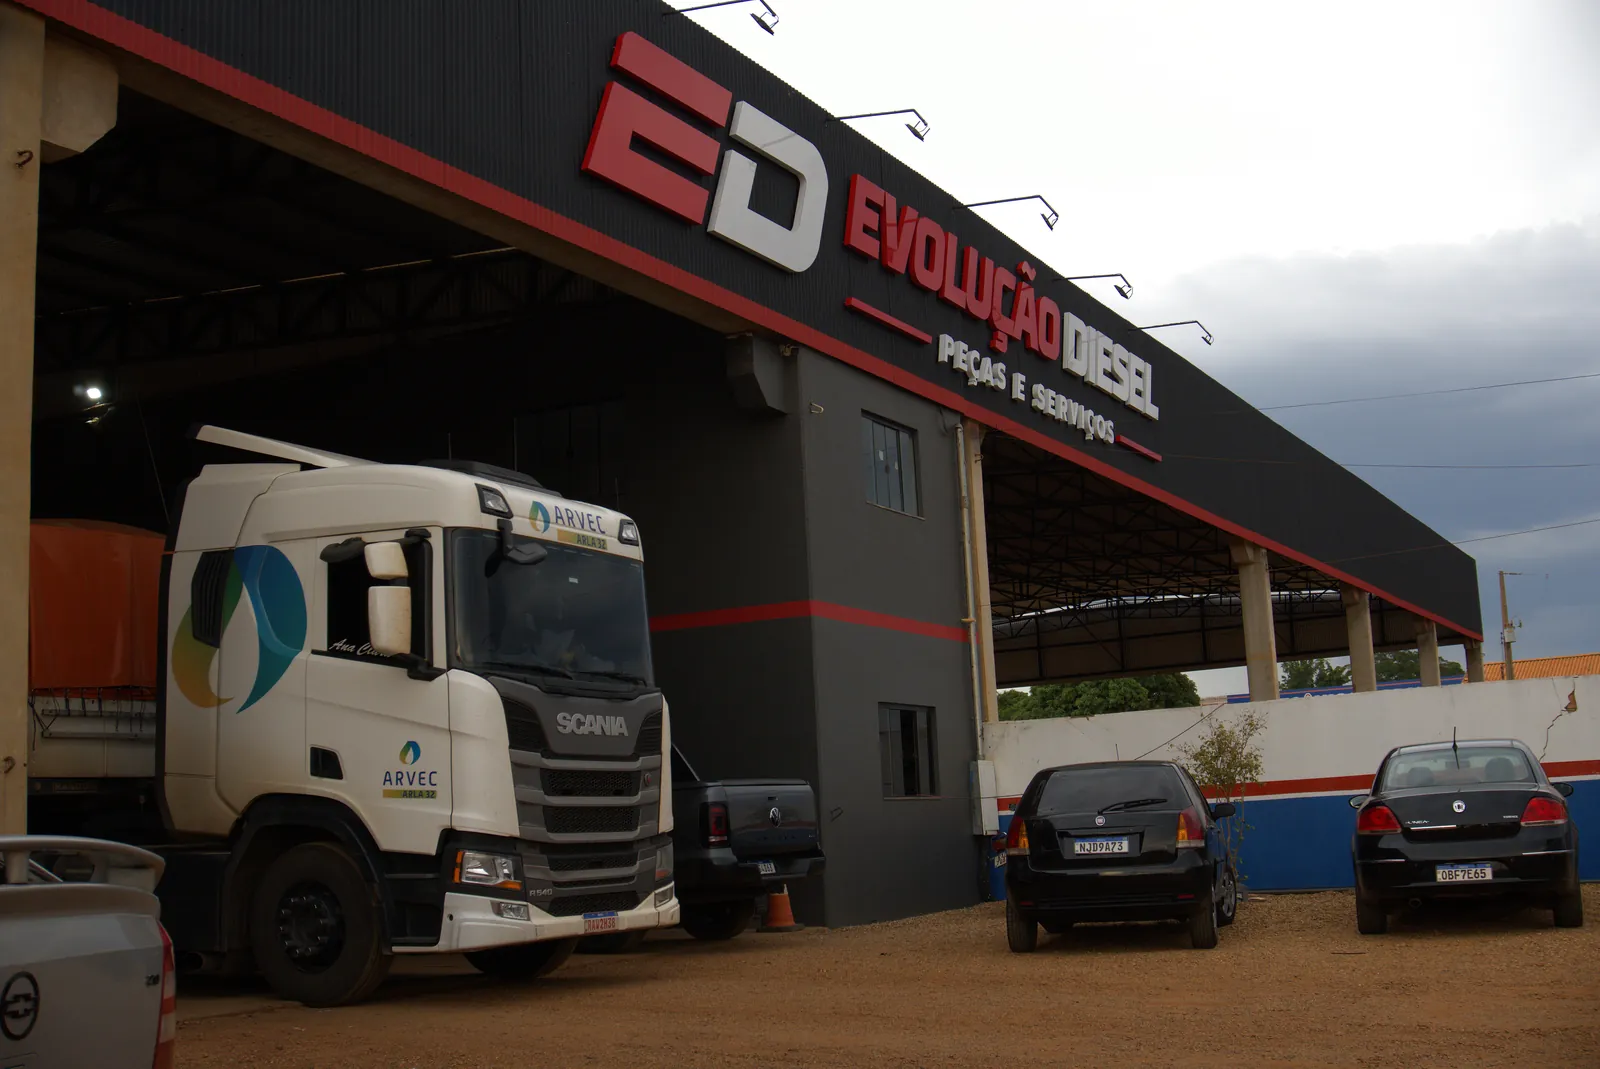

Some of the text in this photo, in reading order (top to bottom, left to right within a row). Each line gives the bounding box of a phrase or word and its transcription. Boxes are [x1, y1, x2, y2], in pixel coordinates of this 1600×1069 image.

[581, 31, 829, 273] ED
[843, 173, 1159, 421] EVOLUÇÃO DIESEL
[938, 333, 1115, 444] PEÇAS E SERVIÇOS
[554, 505, 606, 534] ARVEC
[576, 534, 606, 550] ARLA 32
[328, 638, 357, 653] Ana
[556, 712, 628, 737] SCANIA
[383, 771, 437, 786] ARVEC
[402, 790, 435, 799] ARLA 32
[1079, 841, 1123, 853] NJD9A73
[1441, 868, 1486, 881] OBF7E65
